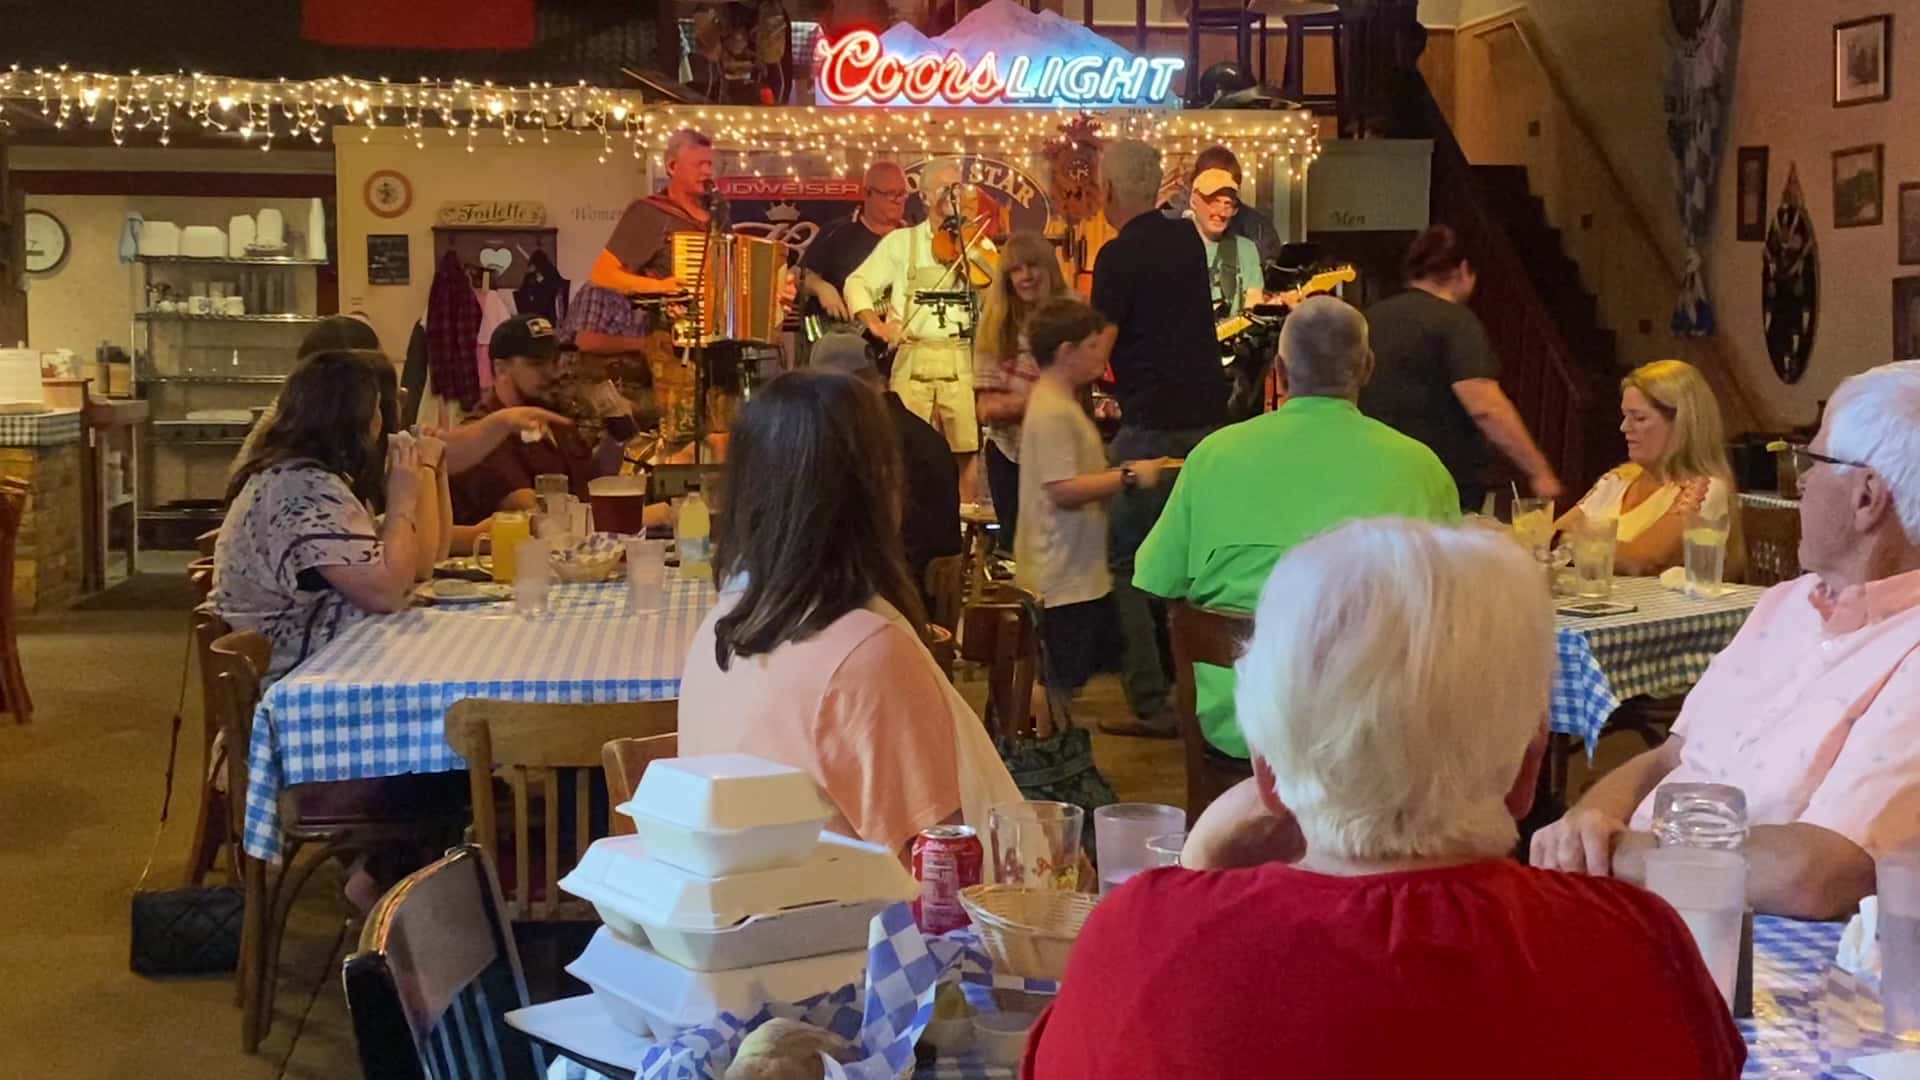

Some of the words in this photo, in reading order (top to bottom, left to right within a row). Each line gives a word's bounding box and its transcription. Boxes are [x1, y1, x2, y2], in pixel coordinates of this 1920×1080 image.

[816, 29, 1000, 104] Coors
[1004, 55, 1184, 101] LIGHT
[718, 182, 860, 196] UDWEISER
[969, 163, 1035, 209] STAR
